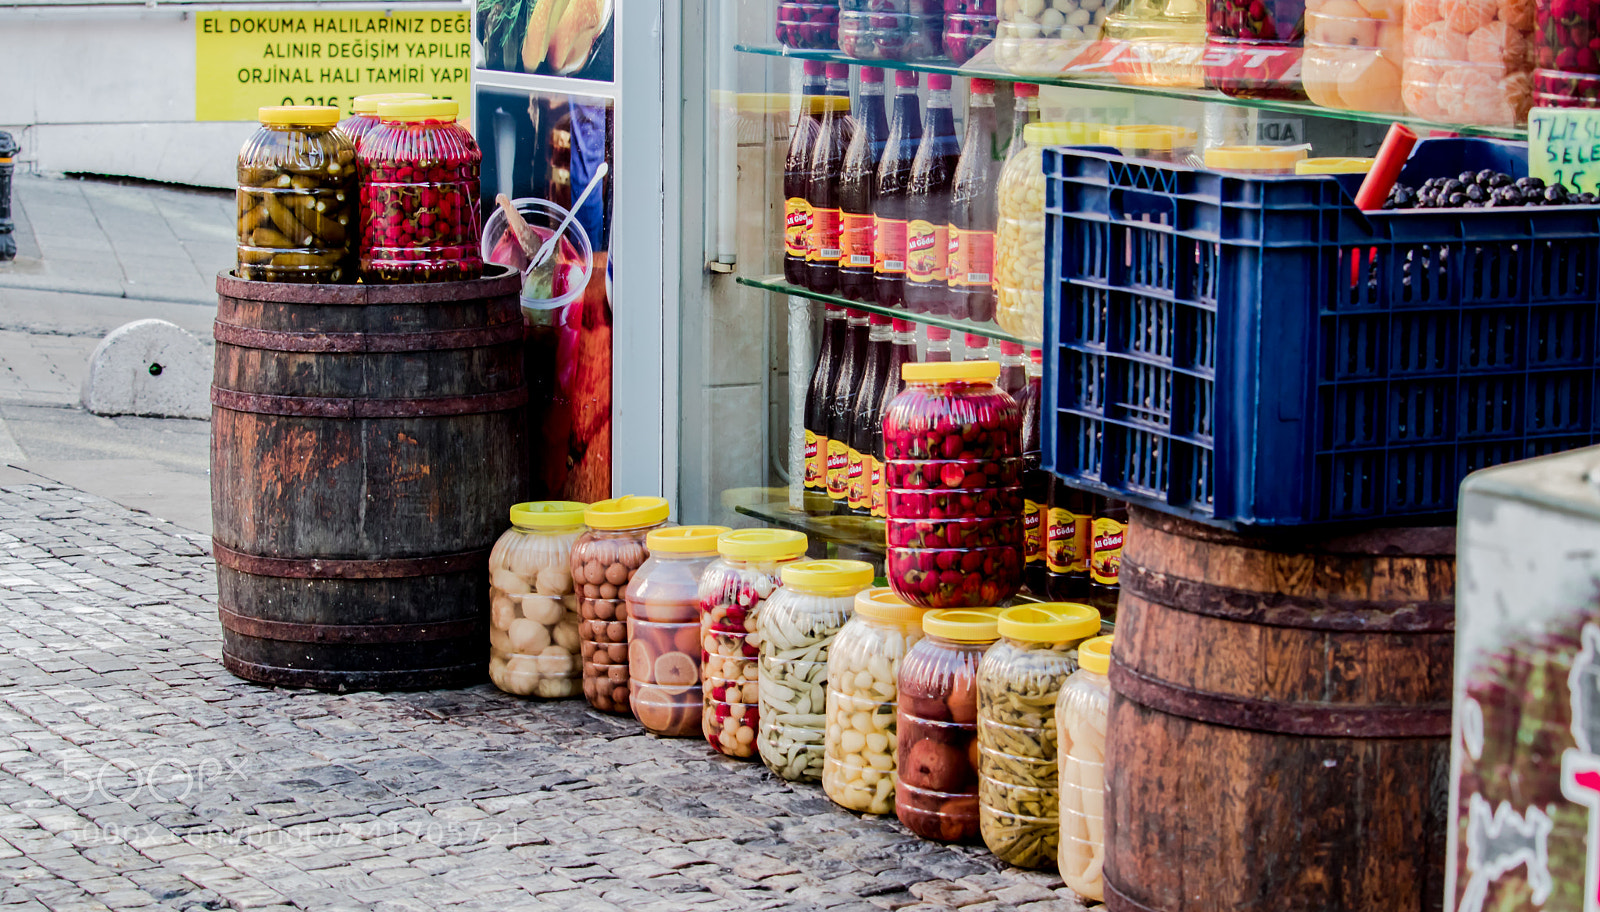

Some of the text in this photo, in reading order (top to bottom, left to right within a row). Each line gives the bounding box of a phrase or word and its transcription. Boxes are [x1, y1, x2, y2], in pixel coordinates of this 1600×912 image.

[203, 18, 224, 33] EL
[230, 18, 307, 33] DOKUMA
[313, 18, 424, 33] HALILARINIZ
[263, 38, 471, 61] ALINIR DEĞİŞİM YAPILIR
[237, 64, 313, 83] ORJİNAL
[320, 68, 360, 83] HALI
[366, 64, 424, 83] TAMİRİ
[1025, 516, 1039, 525] öde
